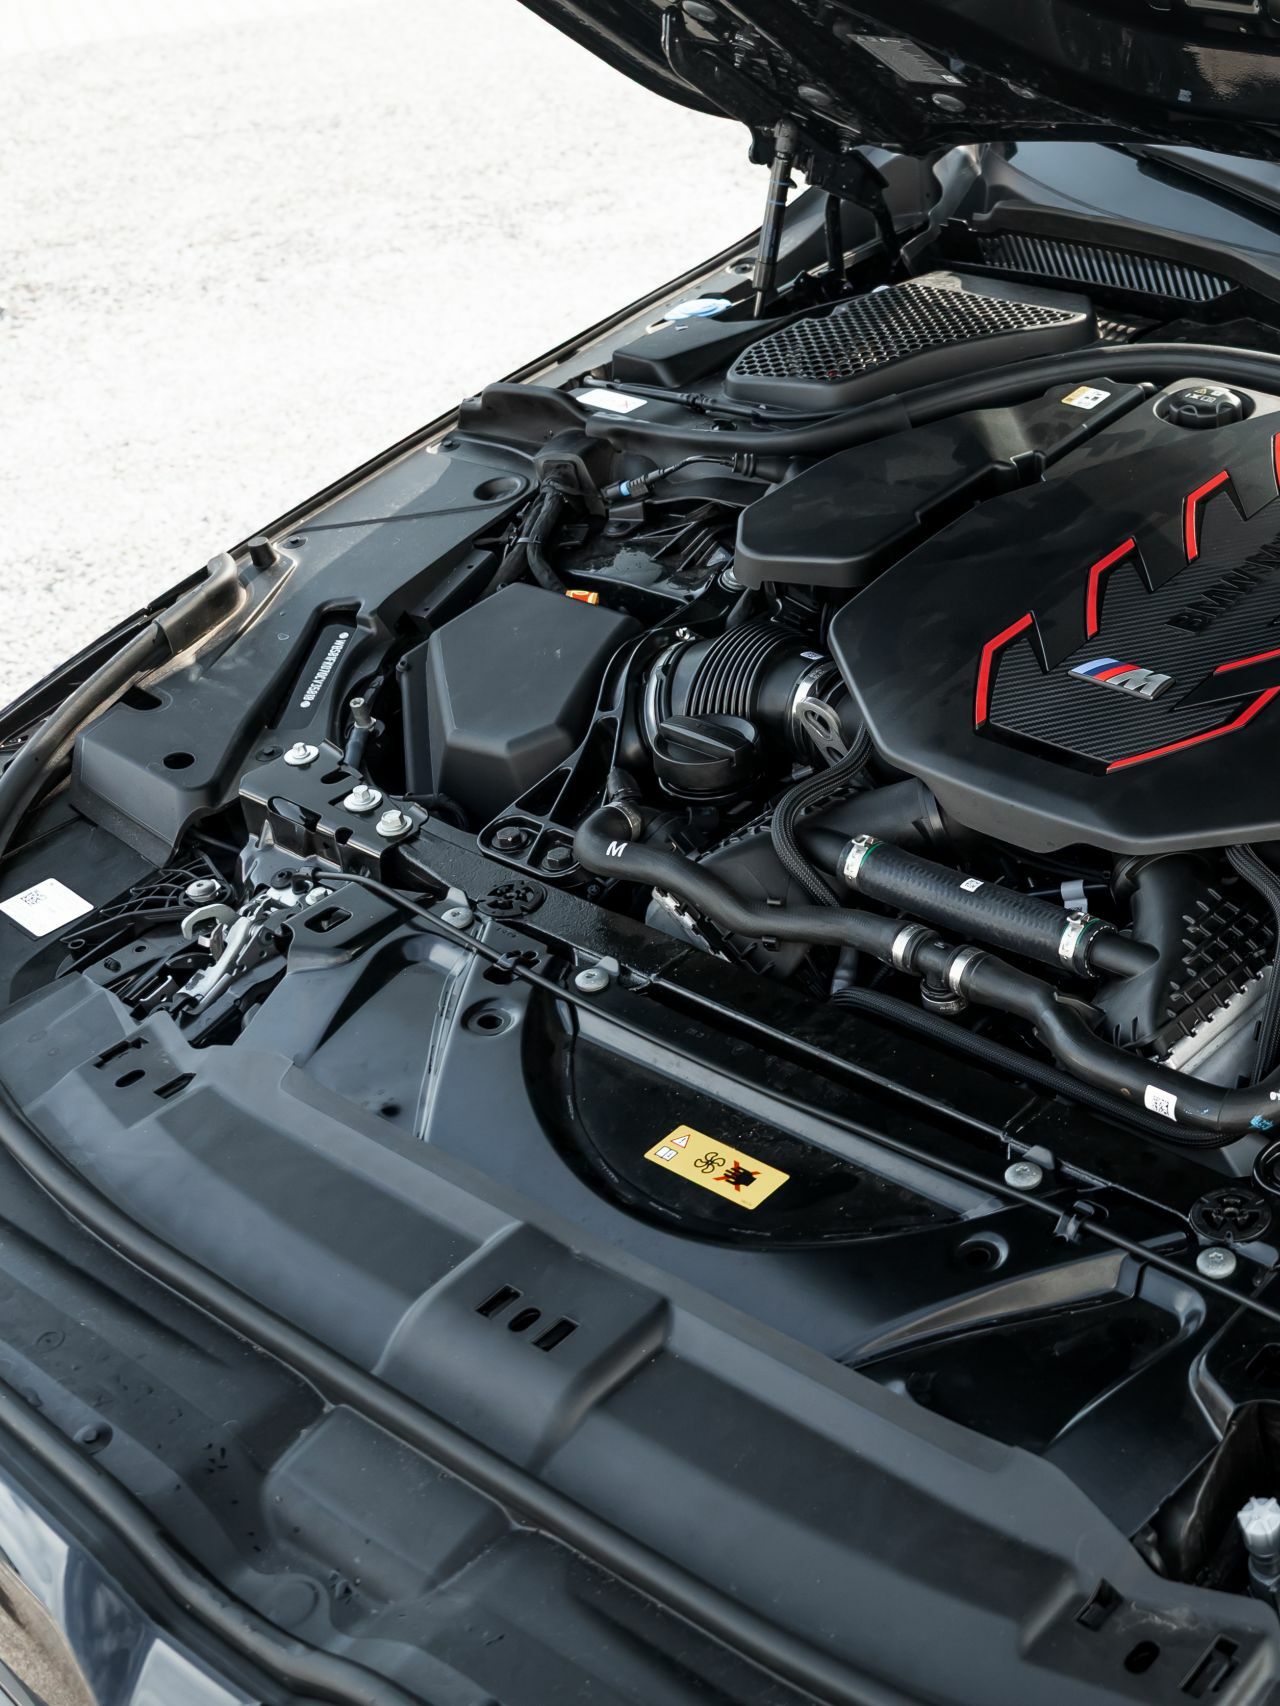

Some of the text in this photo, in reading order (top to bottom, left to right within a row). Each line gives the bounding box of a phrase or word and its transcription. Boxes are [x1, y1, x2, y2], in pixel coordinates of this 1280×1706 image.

[1164, 569, 1262, 637] BMW
[1104, 667, 1173, 698] M
[606, 841, 628, 858] M
